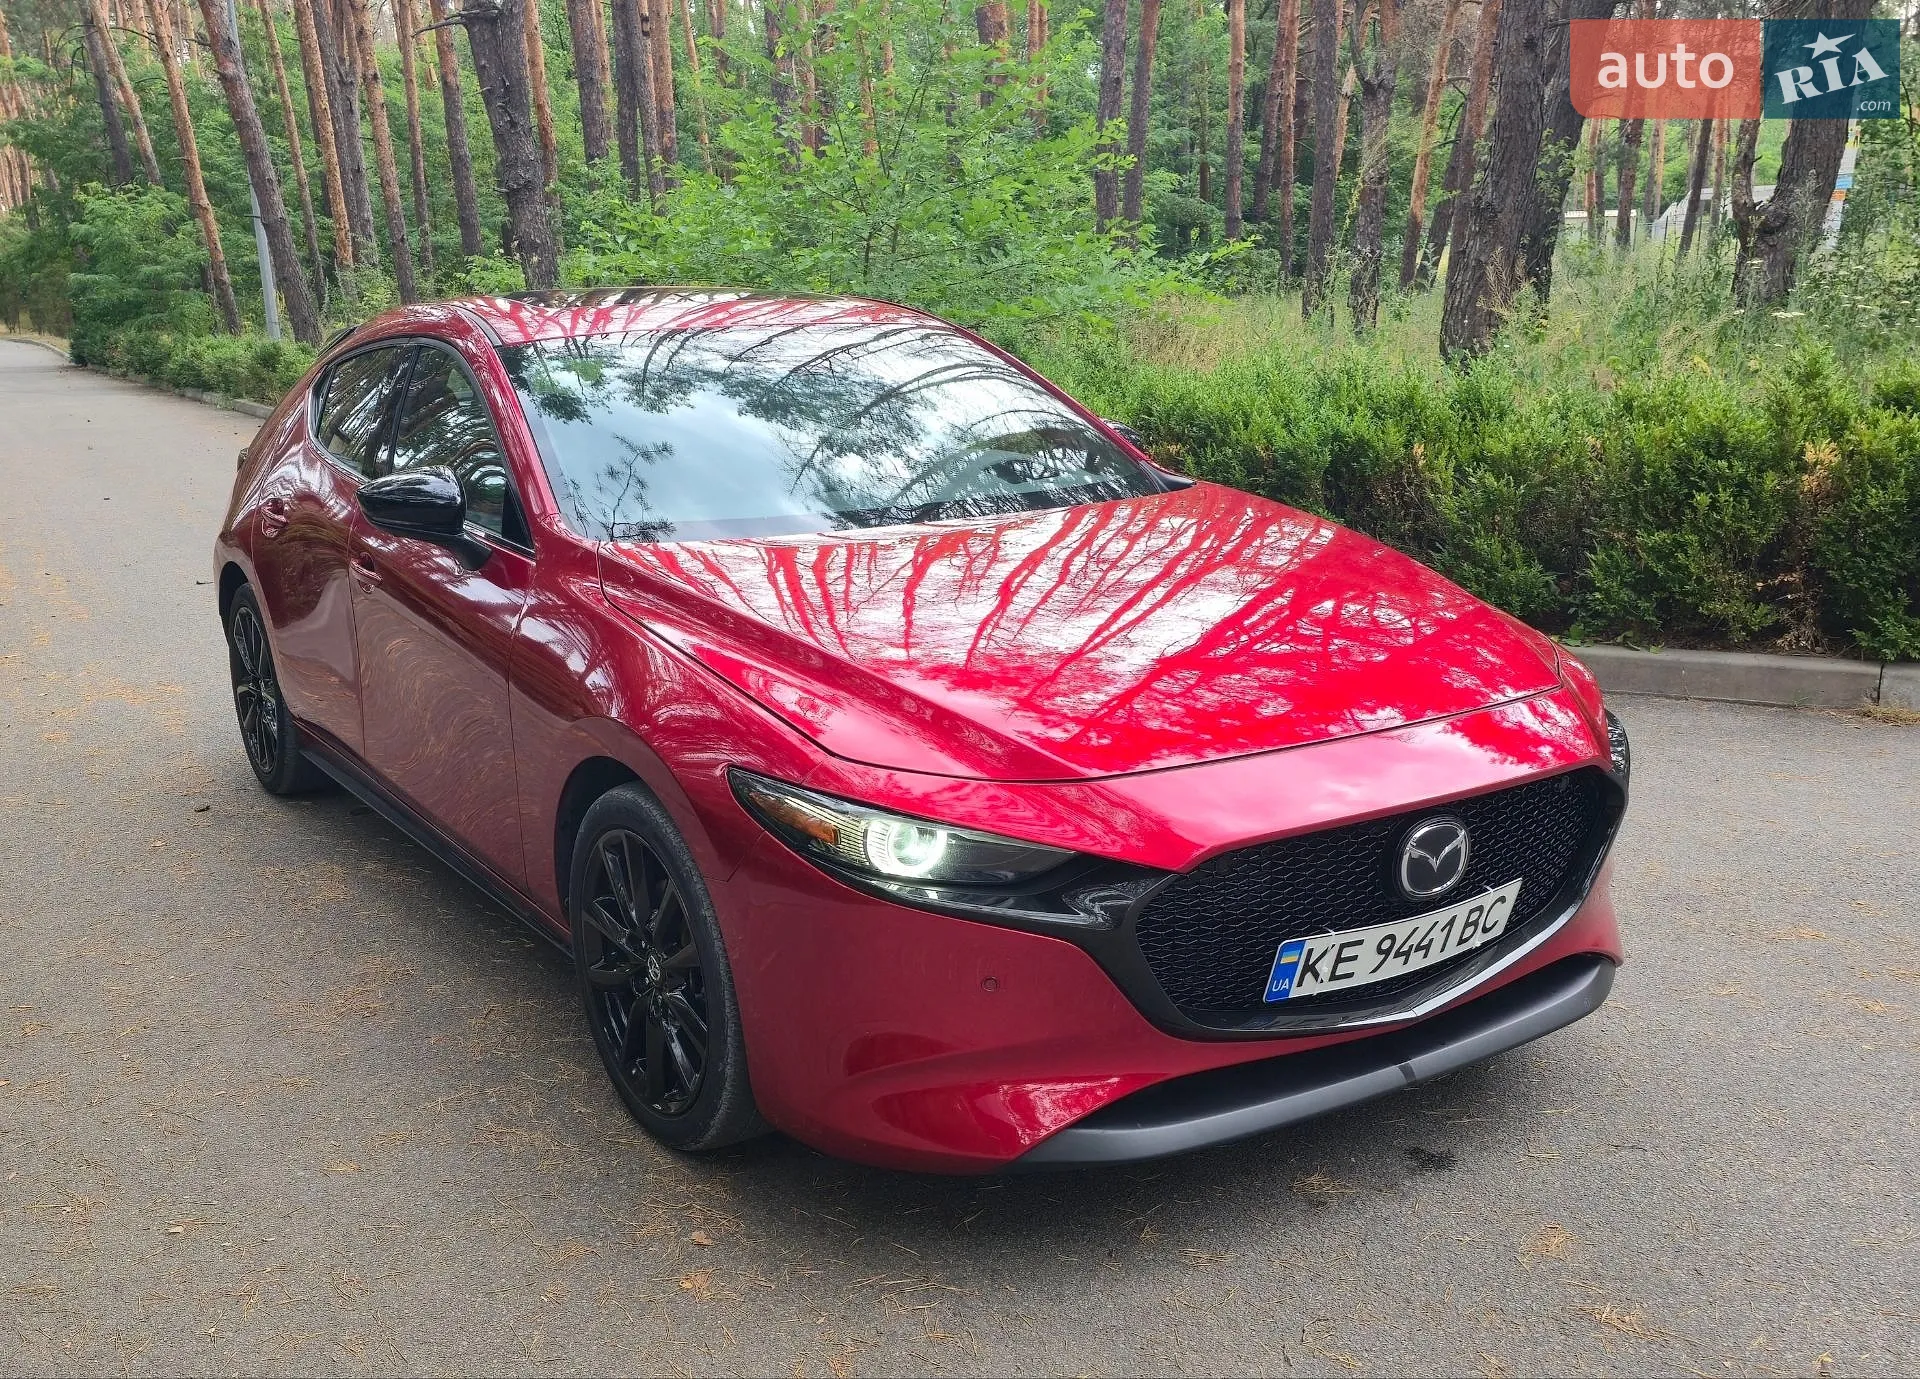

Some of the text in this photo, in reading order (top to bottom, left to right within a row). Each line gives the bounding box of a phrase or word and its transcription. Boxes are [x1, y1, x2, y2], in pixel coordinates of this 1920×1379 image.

[1296, 895, 1507, 988] KE 9441 BC
[1272, 978, 1289, 992] UA
